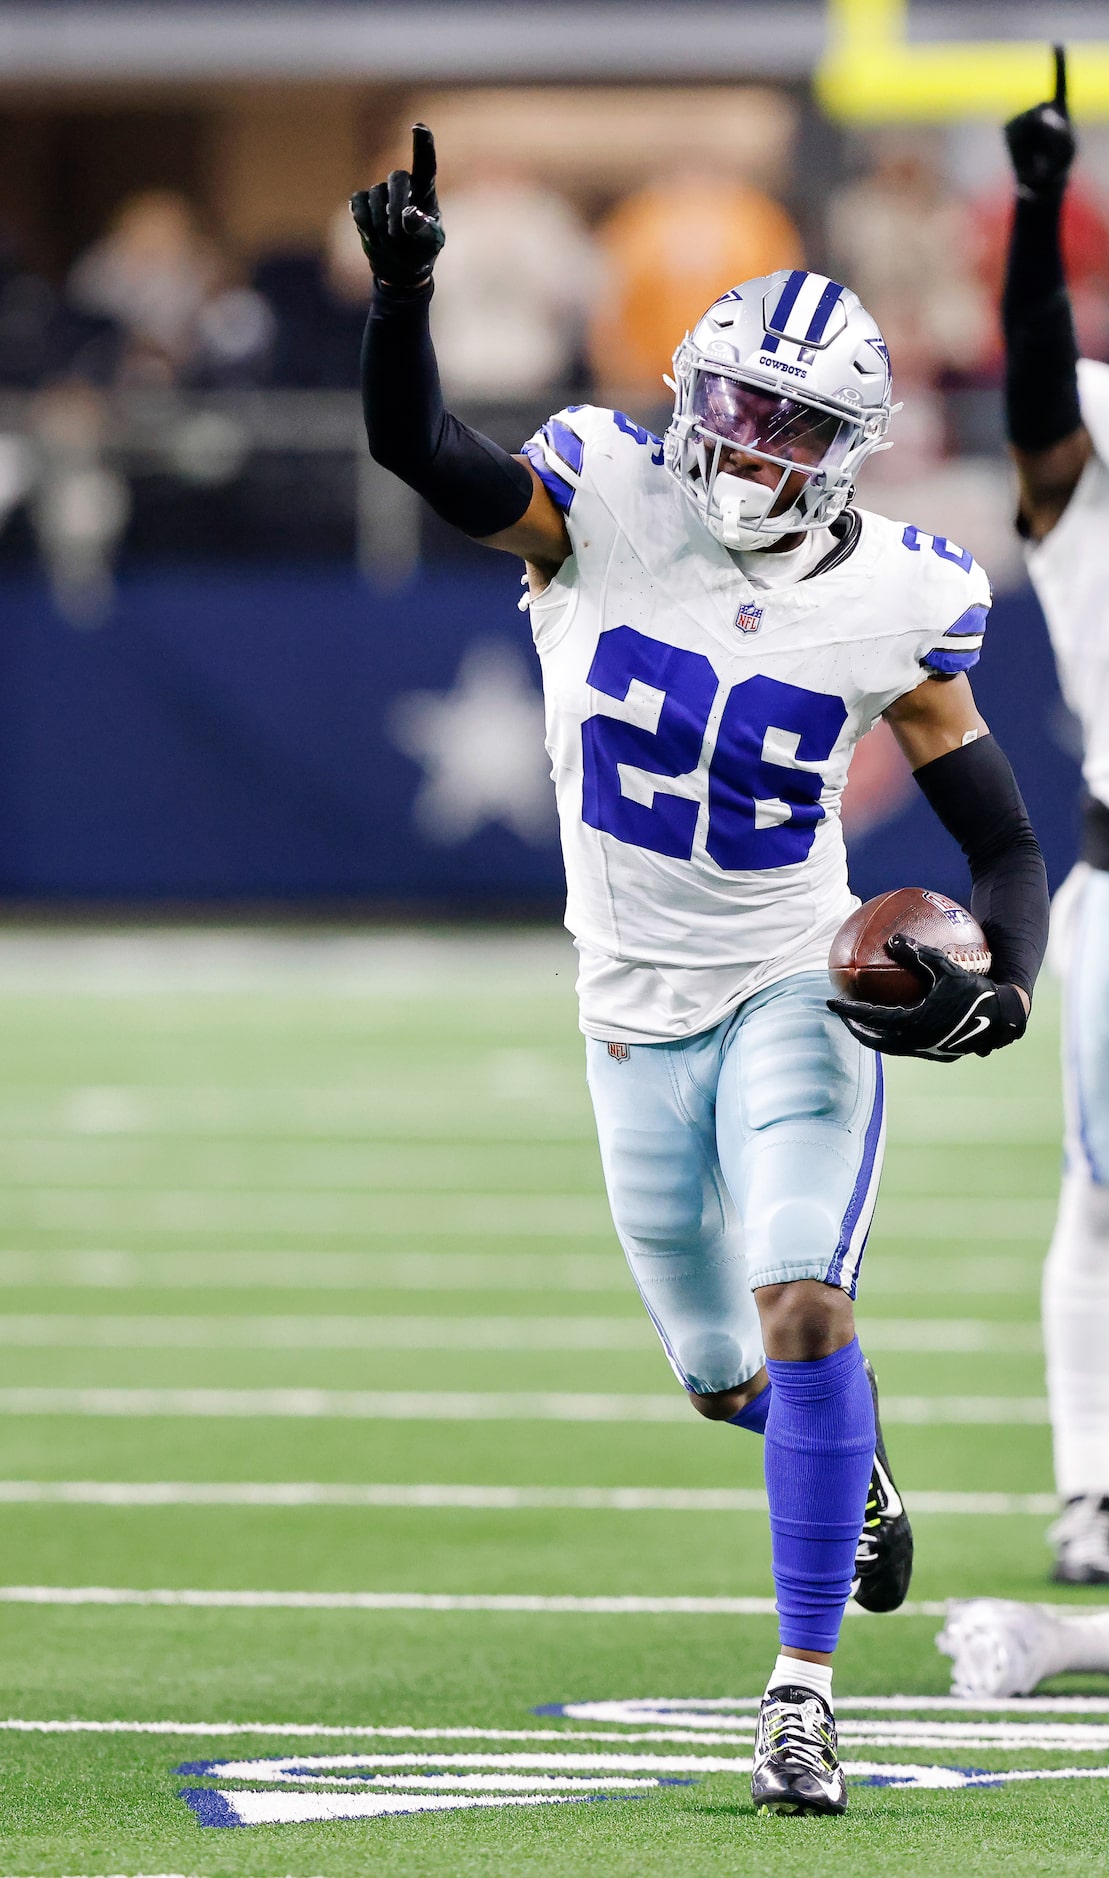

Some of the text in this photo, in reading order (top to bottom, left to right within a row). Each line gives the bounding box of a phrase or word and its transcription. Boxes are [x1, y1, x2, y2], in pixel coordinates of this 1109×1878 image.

[759, 356, 807, 379] COWBOYS
[737, 614, 757, 630] NFL
[581, 624, 849, 871] 26
[609, 1043, 626, 1057] NFL
